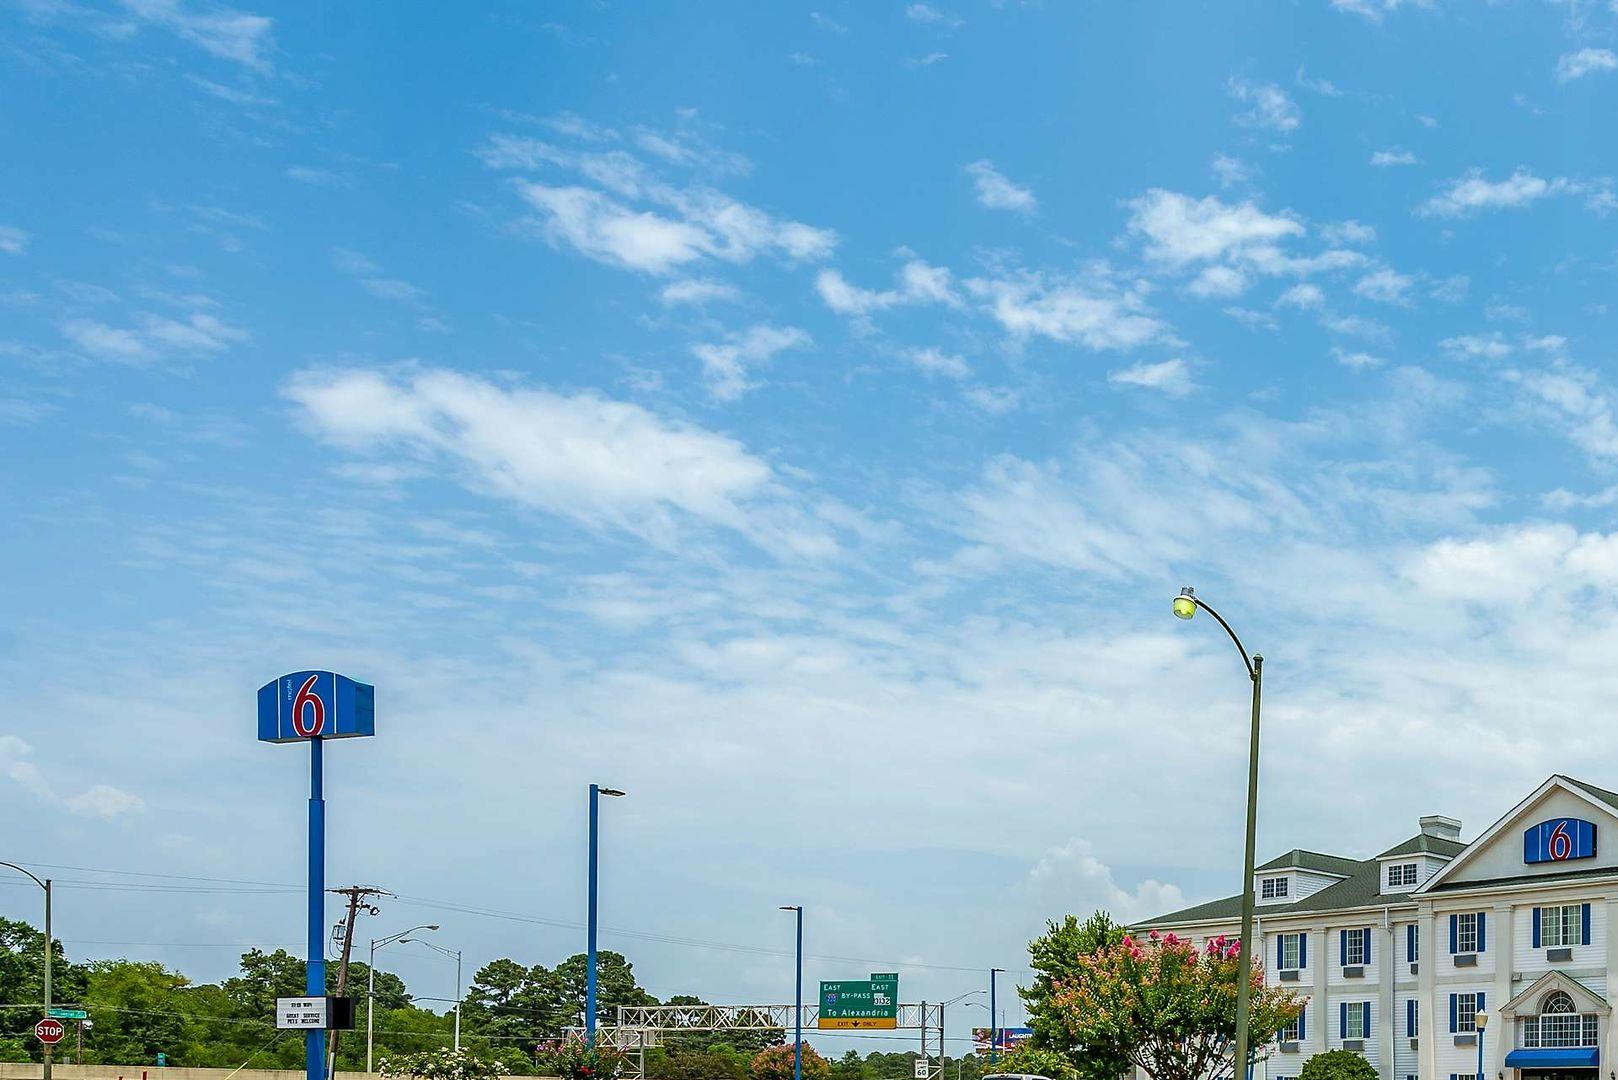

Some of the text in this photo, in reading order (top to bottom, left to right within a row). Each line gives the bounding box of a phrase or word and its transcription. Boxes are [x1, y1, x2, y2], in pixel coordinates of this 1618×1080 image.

[292, 674, 325, 737] 6
[1548, 820, 1572, 861] 6
[823, 983, 841, 991] EAST
[871, 983, 889, 991] EAST
[827, 1009, 889, 1017] To Alexandria
[37, 1026, 62, 1036] STOP
